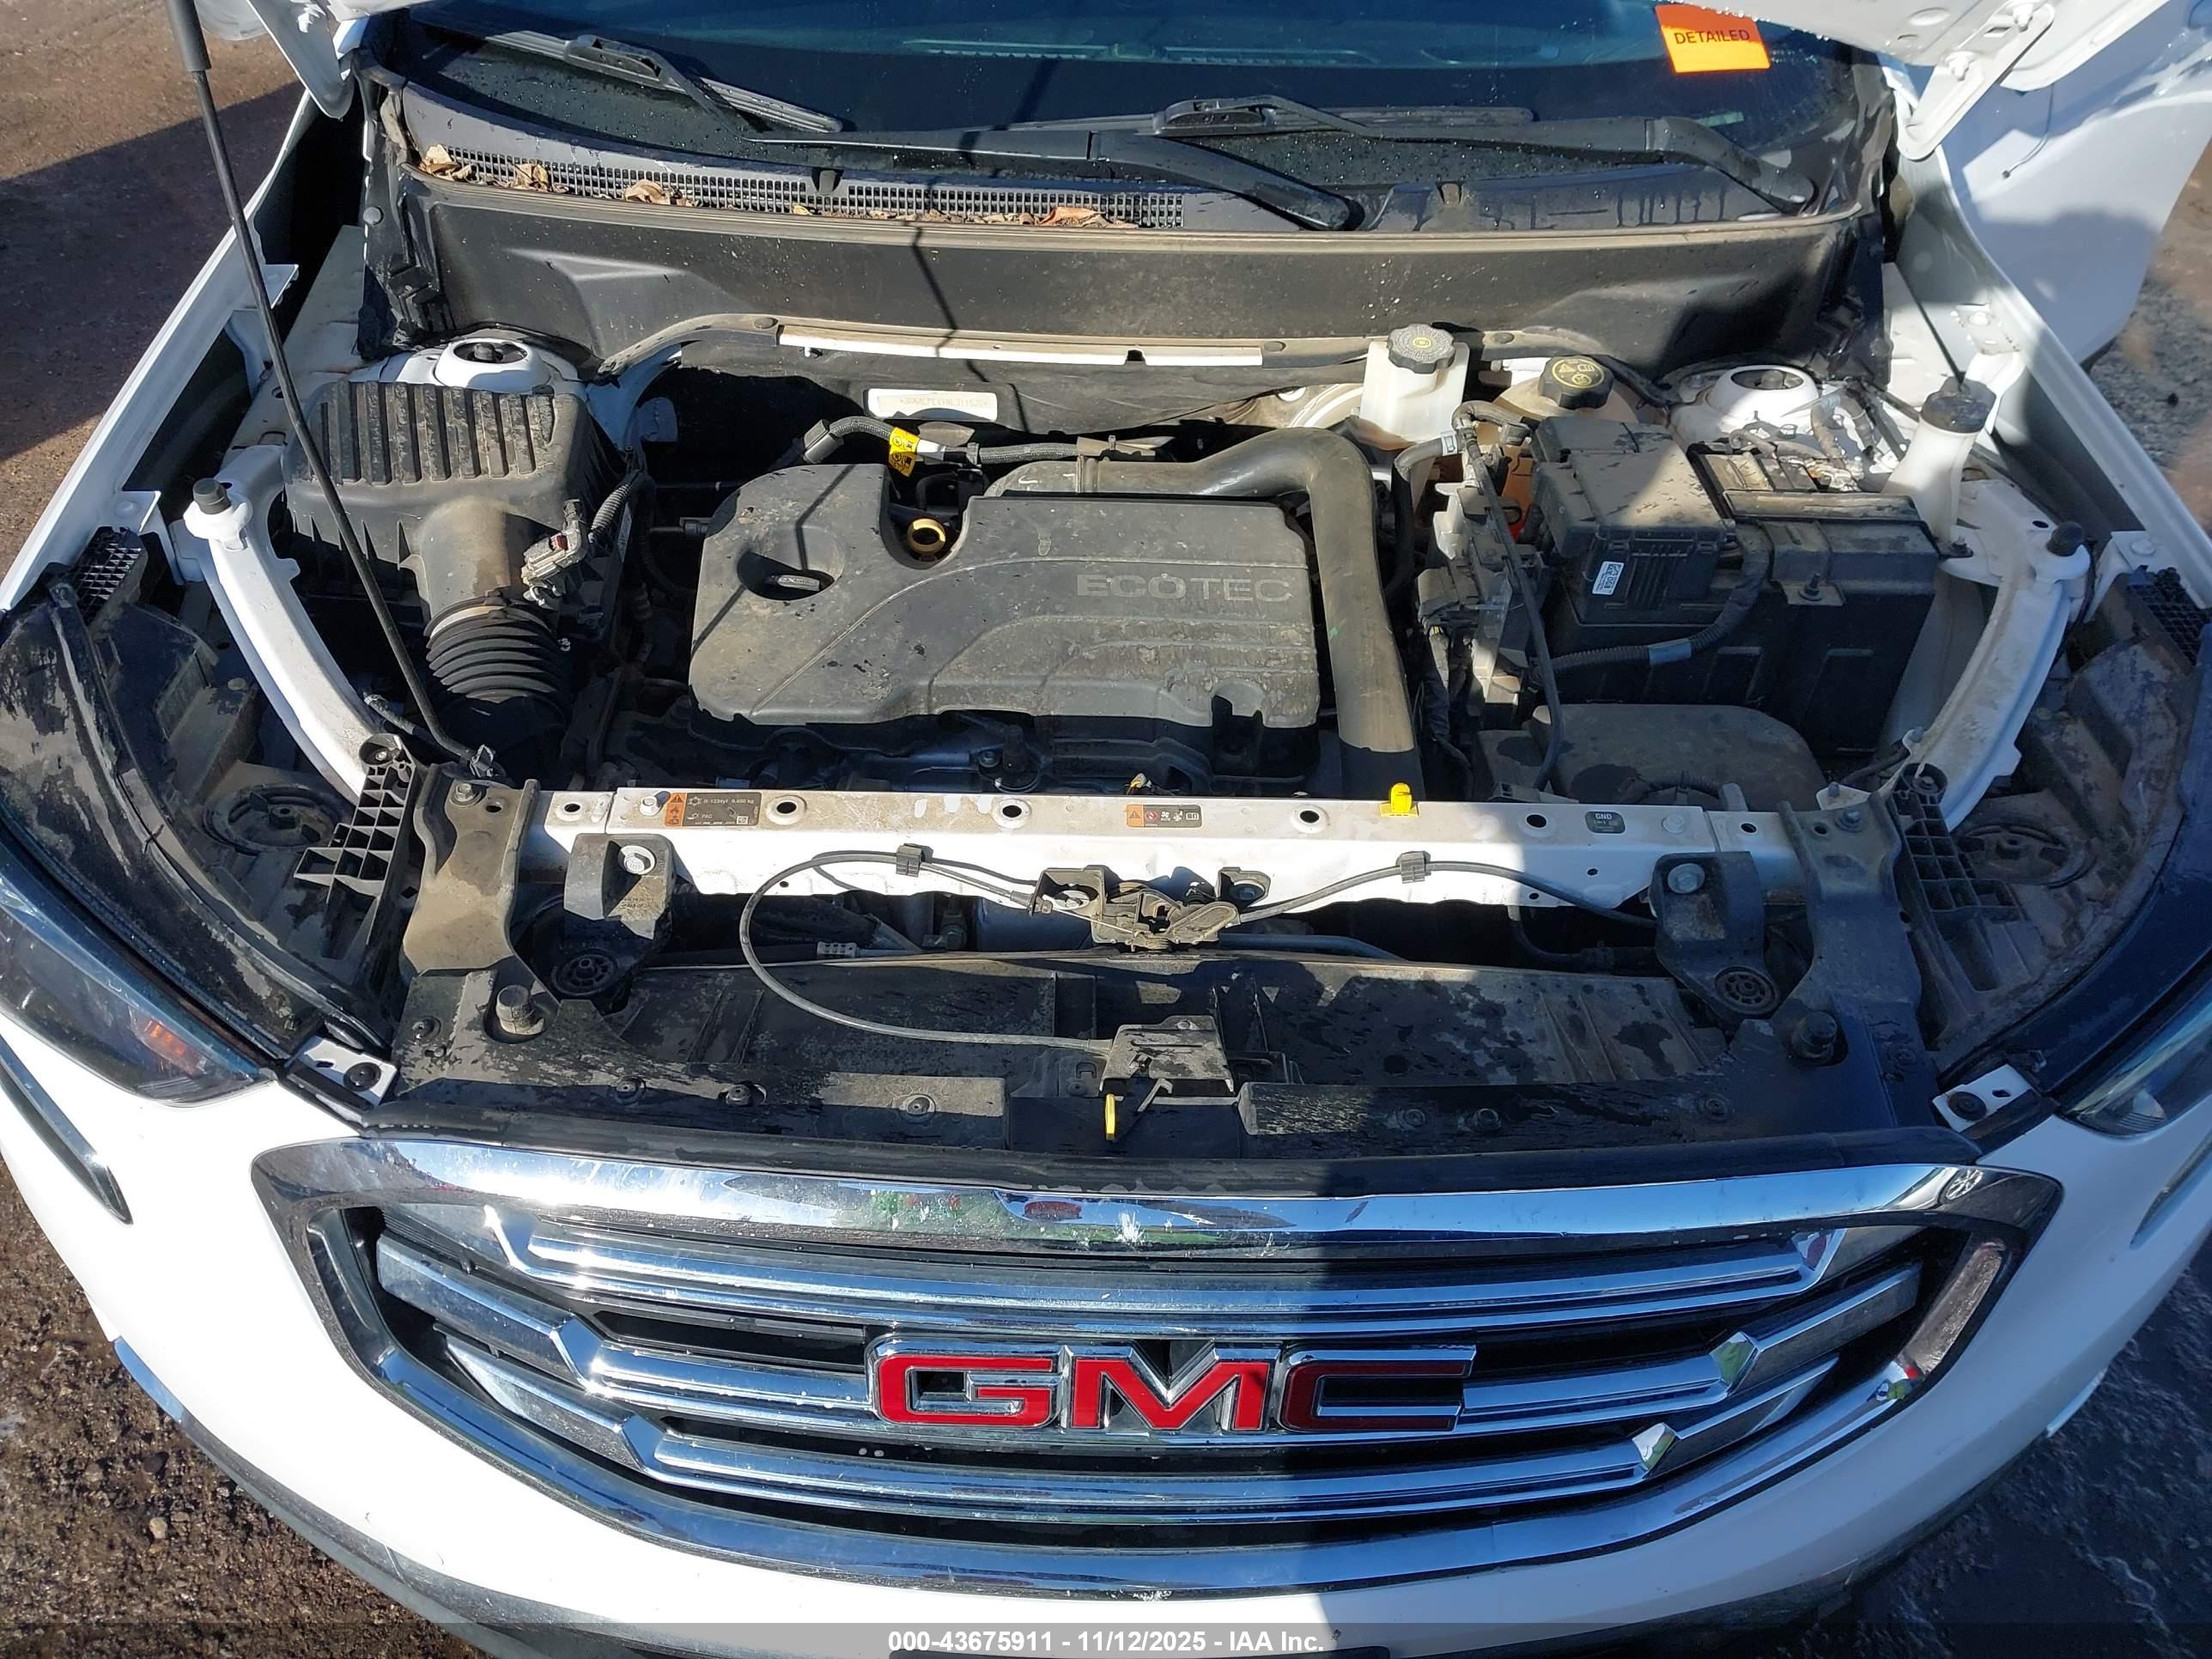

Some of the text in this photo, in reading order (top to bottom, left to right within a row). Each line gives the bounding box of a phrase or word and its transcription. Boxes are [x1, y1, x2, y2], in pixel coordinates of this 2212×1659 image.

[1674, 28, 1751, 45] DETAILED
[1077, 574, 1292, 602] ECOTEC
[867, 1334, 1477, 1432] GMC
